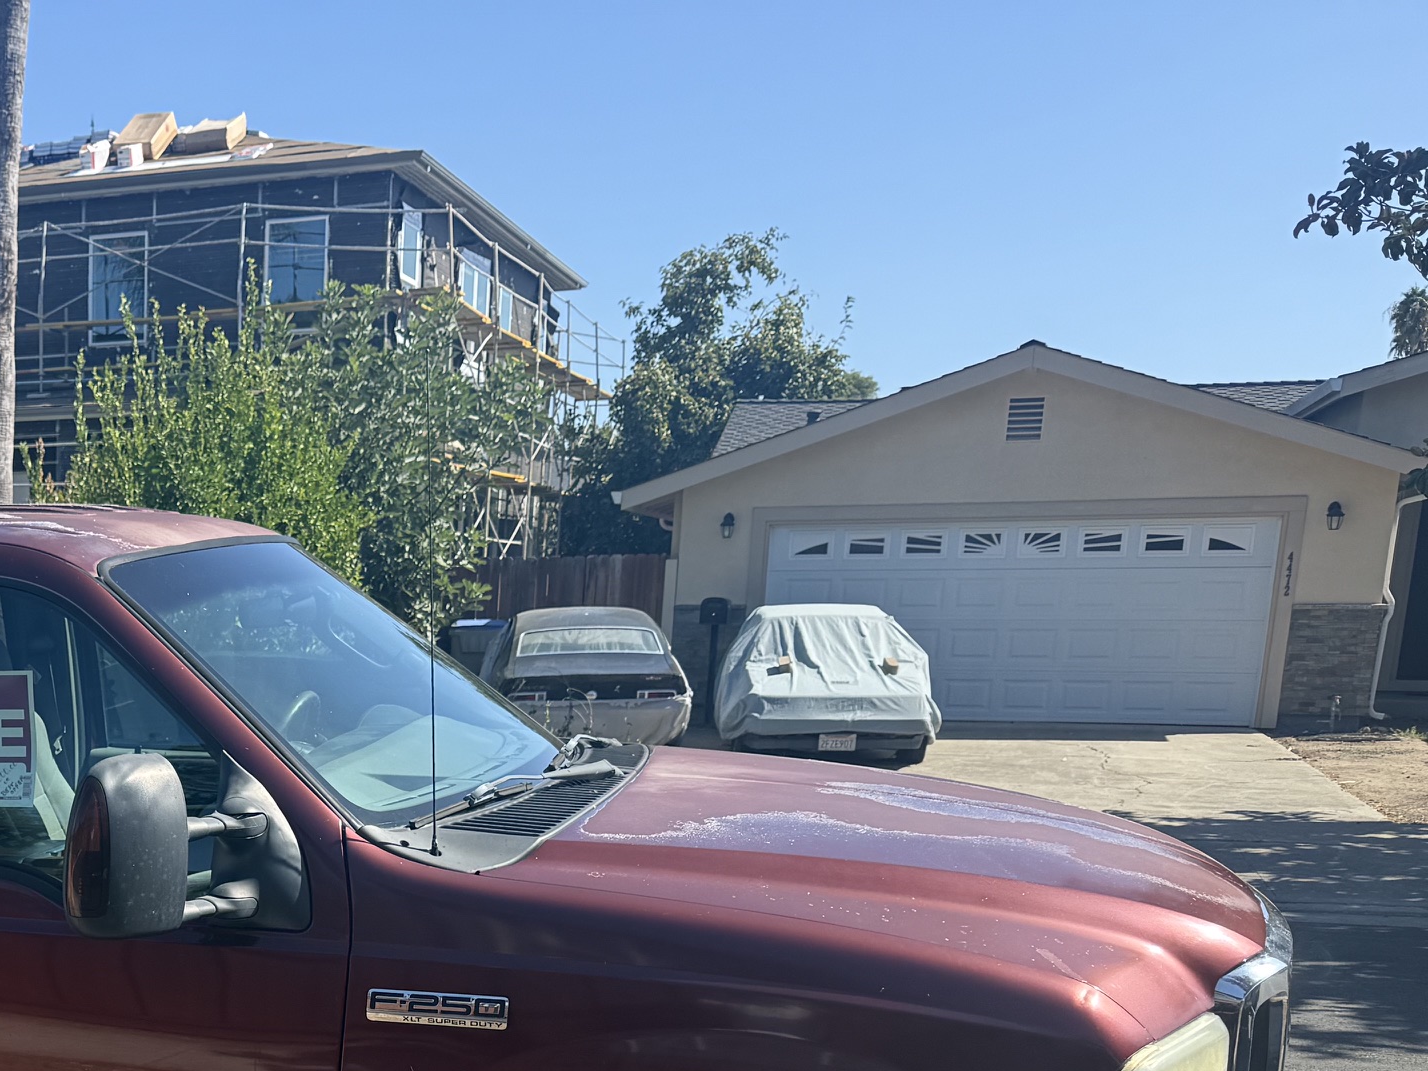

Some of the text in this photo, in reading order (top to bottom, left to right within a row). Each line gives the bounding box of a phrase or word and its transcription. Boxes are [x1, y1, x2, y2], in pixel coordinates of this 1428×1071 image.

[369, 990, 506, 1019] F-250
[402, 1015, 503, 1028] XLT SUPER DUTY
